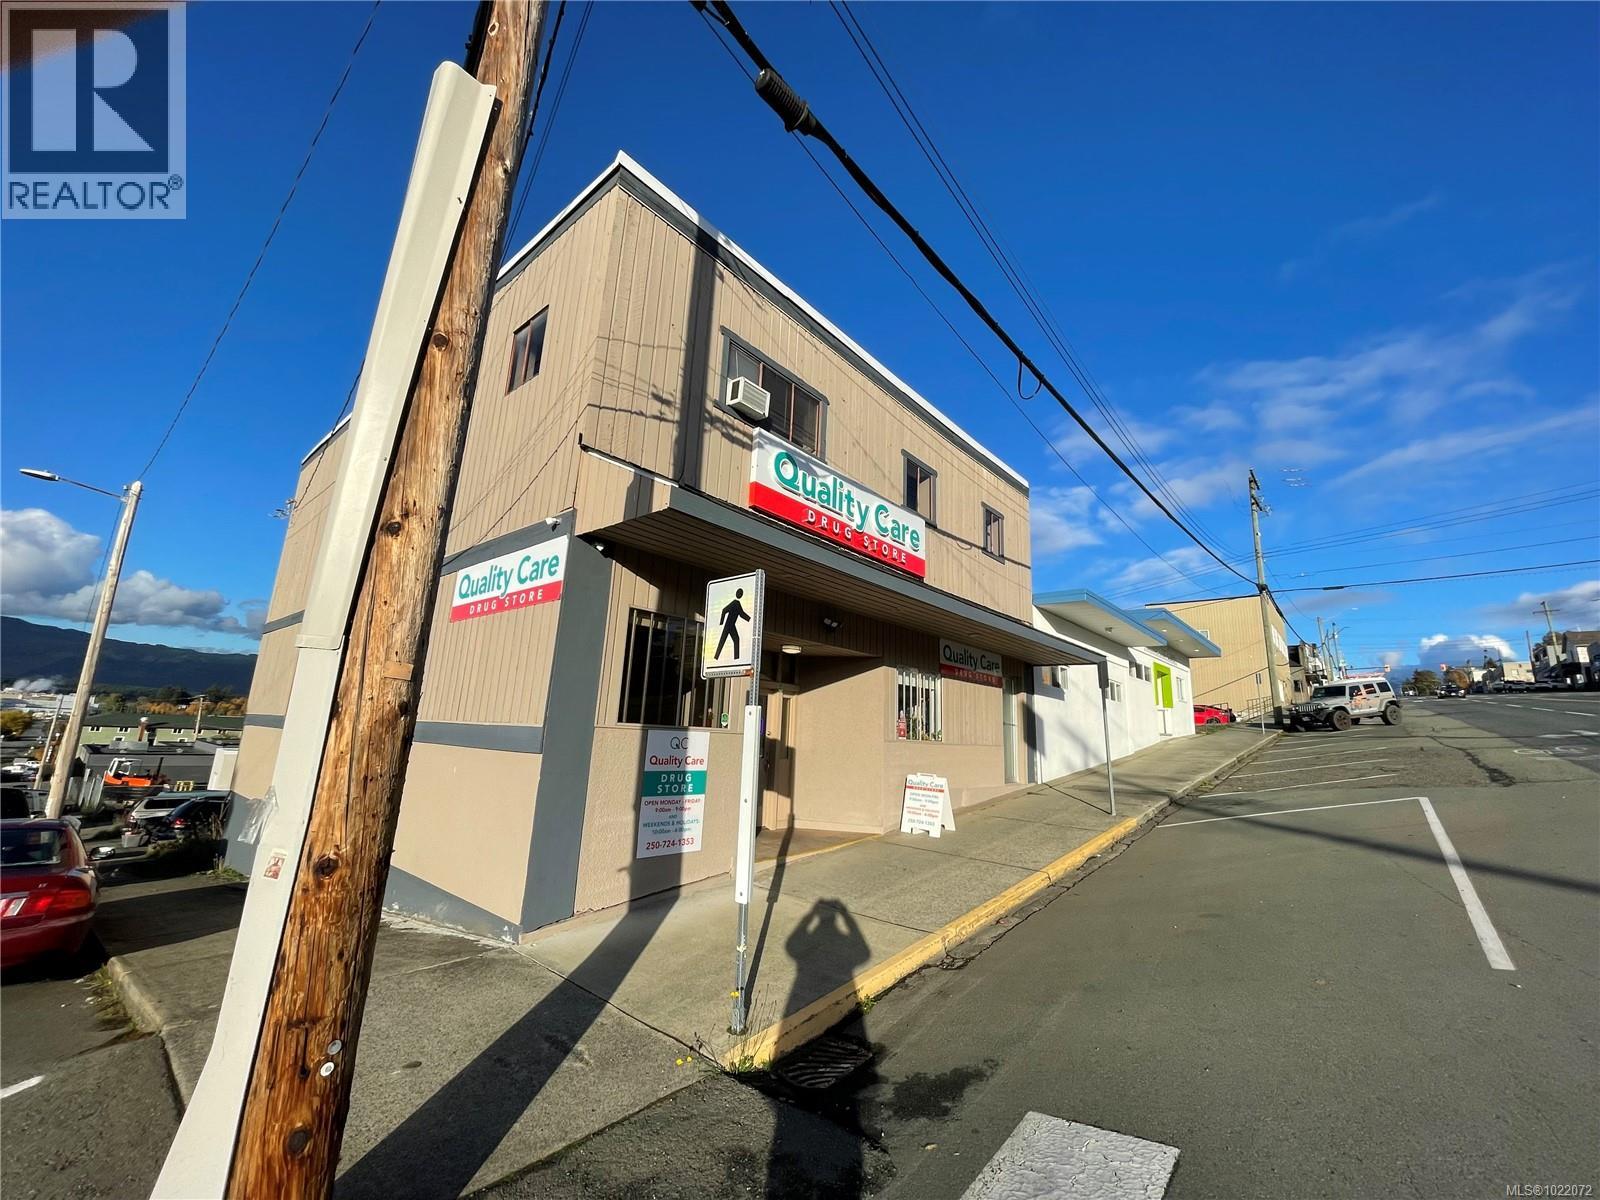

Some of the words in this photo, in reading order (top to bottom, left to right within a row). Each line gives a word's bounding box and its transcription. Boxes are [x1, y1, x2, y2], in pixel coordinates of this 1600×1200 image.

[774, 451, 870, 531] Quality
[875, 504, 921, 551] Care
[808, 509, 852, 539] DRUG
[863, 535, 907, 563] STORE
[458, 565, 514, 599] Quality
[517, 553, 560, 584] Care
[469, 600, 497, 615] DRUG
[504, 589, 543, 607] STORE
[943, 644, 978, 671] Quality
[980, 654, 1000, 672] Care
[670, 737, 689, 750] QC
[649, 755, 683, 768] Quality
[684, 756, 705, 766] Care
[660, 773, 692, 783] DRUG
[908, 779, 929, 787] Quality
[657, 783, 694, 793] STORE
[646, 837, 695, 850] 250-724-1353
